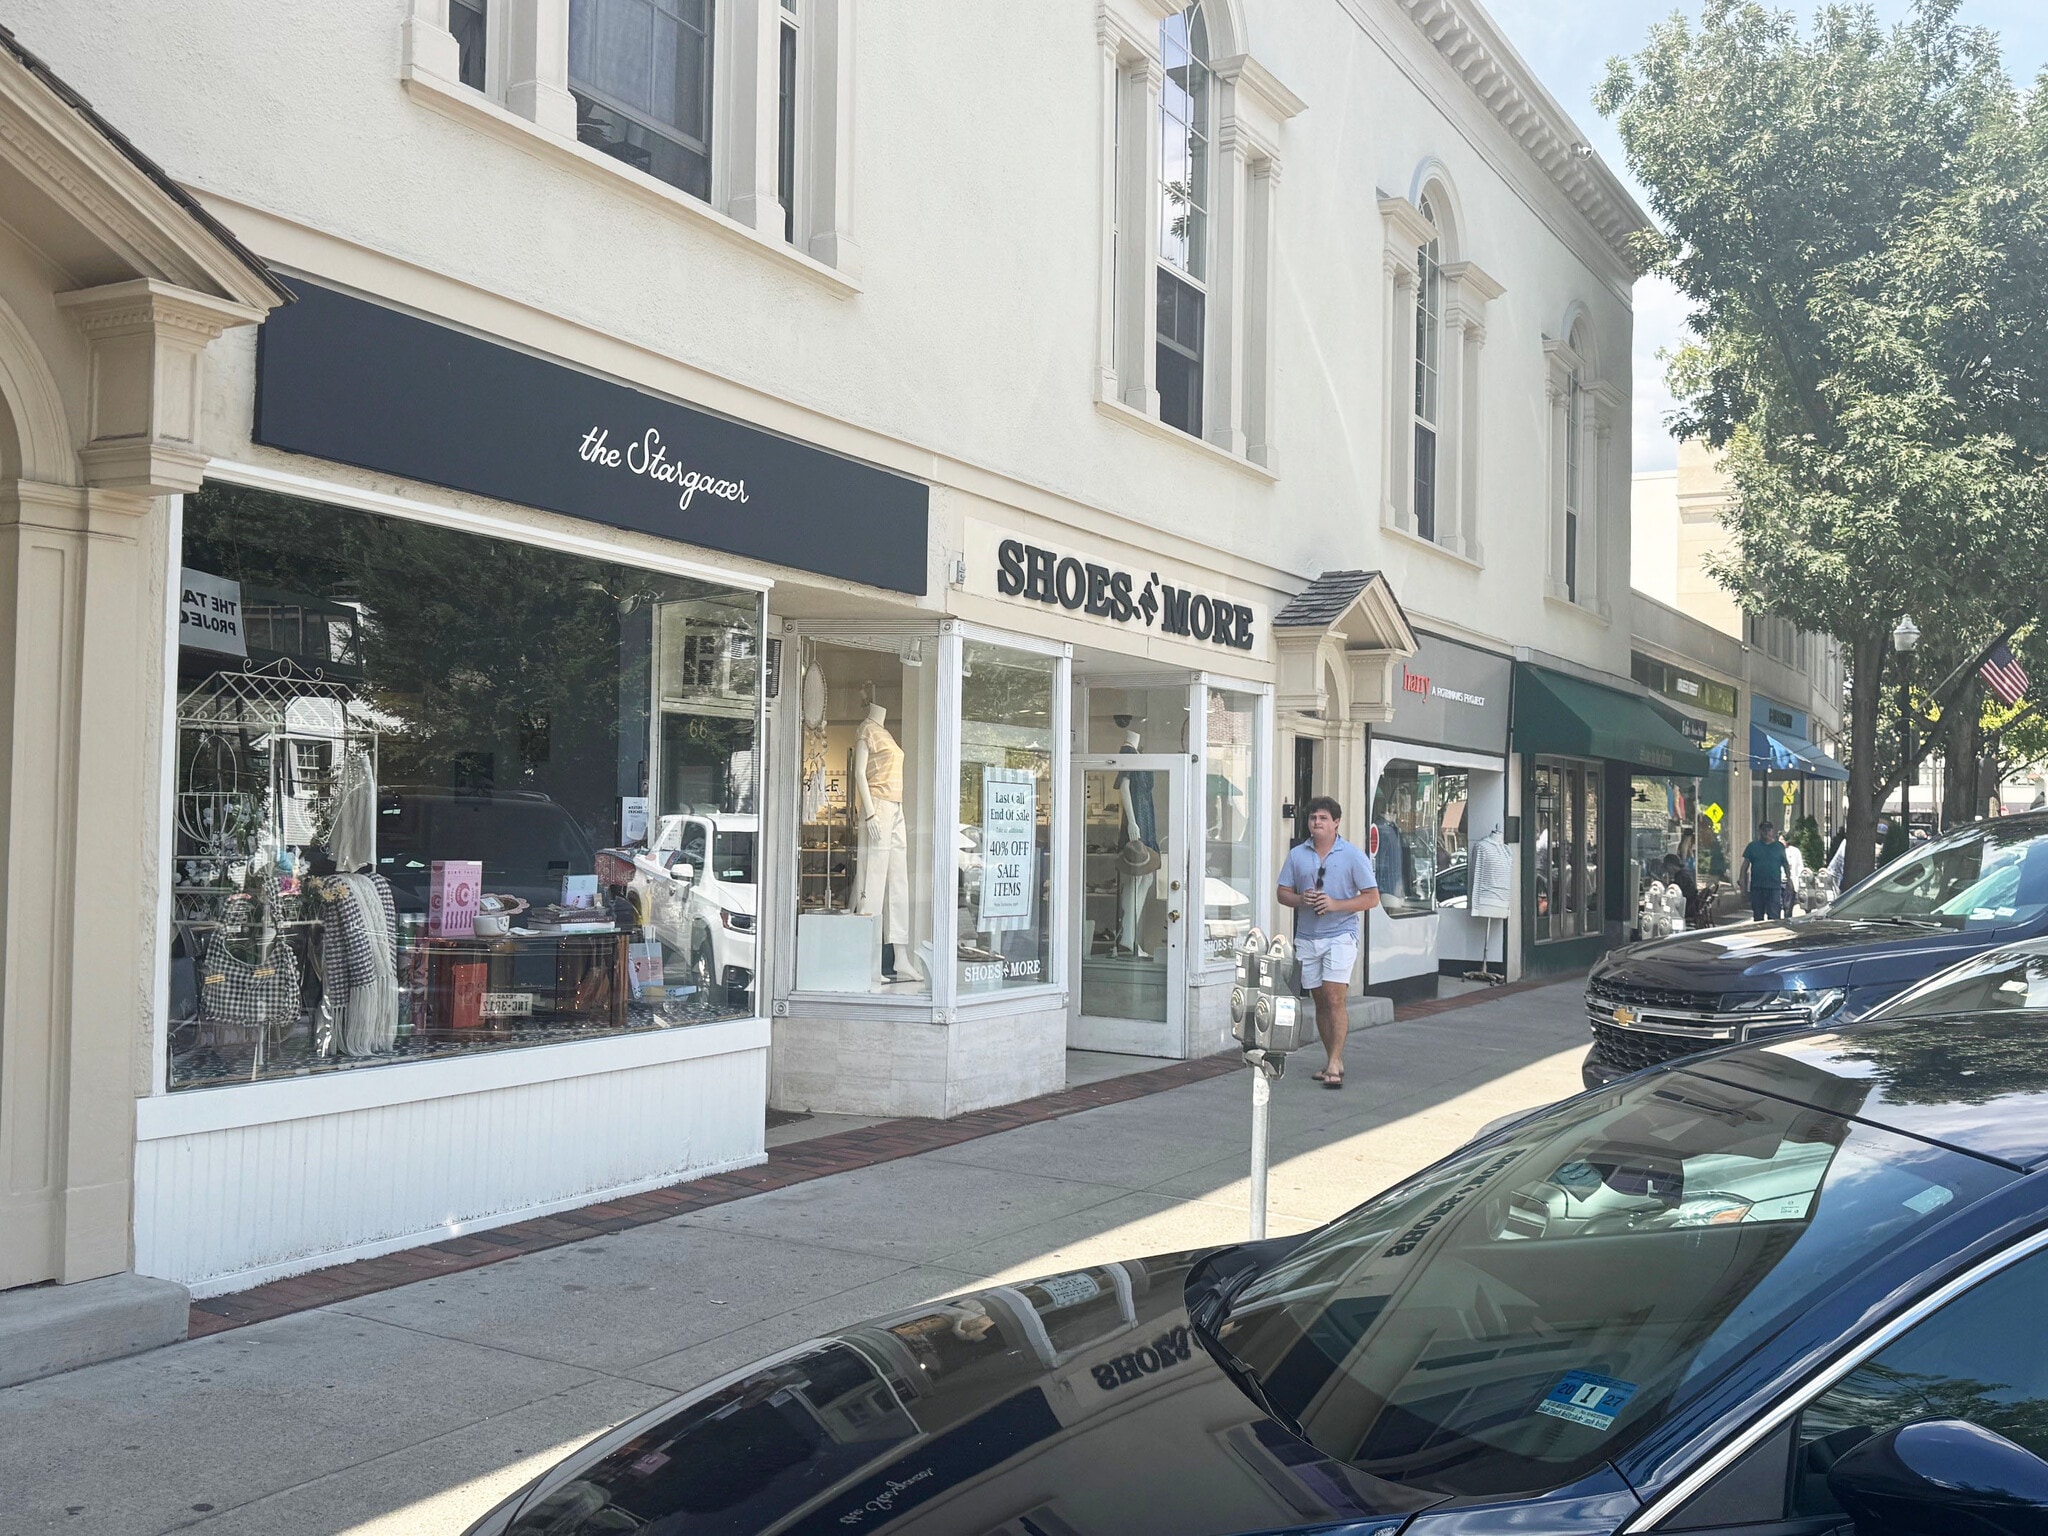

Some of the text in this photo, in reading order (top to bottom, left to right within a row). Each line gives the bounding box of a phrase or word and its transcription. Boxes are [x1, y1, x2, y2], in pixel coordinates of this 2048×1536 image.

[578, 426, 749, 510] the Stargazer
[997, 539, 1133, 622] SHOES
[1161, 585, 1254, 650] MORE
[1403, 662, 1430, 704] harry
[1431, 686, 1437, 696] A
[995, 792, 1010, 804] Last
[990, 808, 1004, 820] End
[1016, 809, 1030, 822] Sale
[990, 841, 1030, 856] 40% OFF
[997, 864, 1020, 879] SALE
[993, 882, 1021, 897] ITEMS
[964, 964, 1001, 982] SHOES
[1010, 960, 1041, 977] MORE
[1557, 1383, 1625, 1407] 20 1 27
